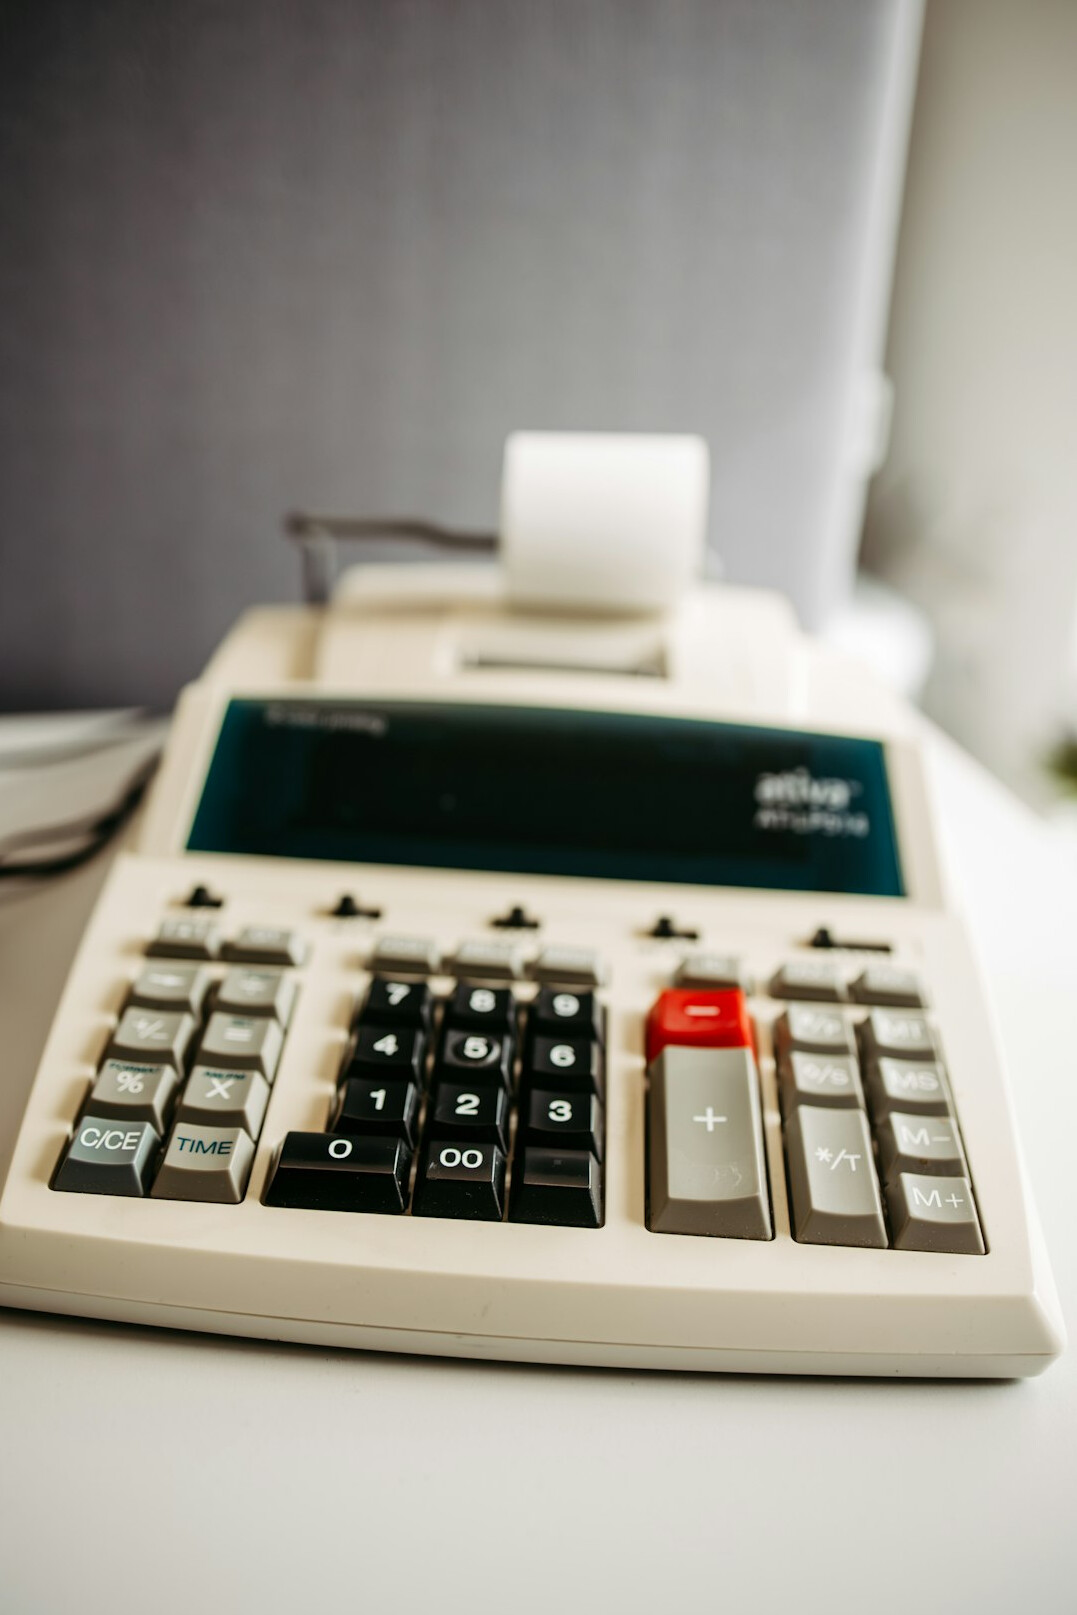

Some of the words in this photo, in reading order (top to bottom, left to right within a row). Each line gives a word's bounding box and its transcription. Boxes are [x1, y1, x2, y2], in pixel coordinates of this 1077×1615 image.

[385, 983, 411, 1006] 7
[469, 989, 497, 1012] 8
[552, 993, 580, 1018] 9
[372, 1034, 399, 1057] 4
[463, 1036, 489, 1060] 5
[549, 1044, 577, 1068] 6
[116, 1071, 145, 1094] %
[889, 1068, 940, 1092] MS
[368, 1088, 387, 1111] 1
[454, 1093, 481, 1116] 2
[547, 1100, 573, 1123] 3
[80, 1127, 142, 1151] C/CE
[176, 1136, 233, 1156] TIME
[327, 1138, 353, 1160] 0
[438, 1148, 484, 1169] 00
[912, 1186, 965, 1210] M+
